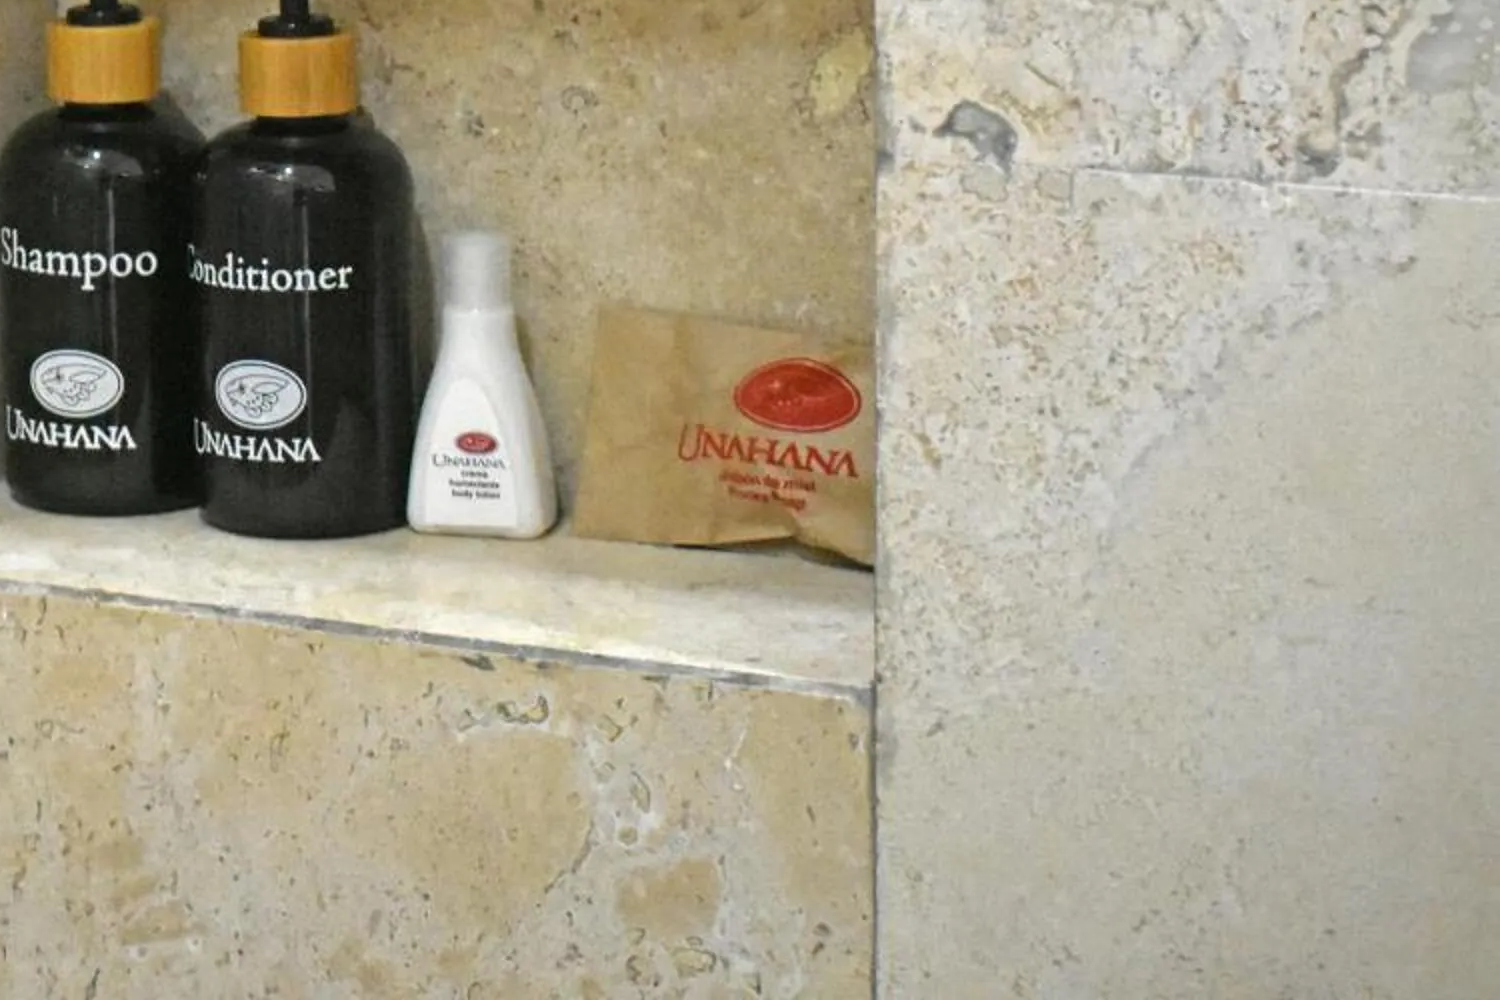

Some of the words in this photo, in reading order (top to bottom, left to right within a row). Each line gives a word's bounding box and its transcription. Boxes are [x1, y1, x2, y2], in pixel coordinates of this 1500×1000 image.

[0, 226, 158, 291] Shampoo
[5, 405, 137, 451] UNAHANA
[193, 416, 322, 463] UNAHANA
[678, 423, 859, 478] UNAHANA
[432, 454, 506, 469] UNAHANA
